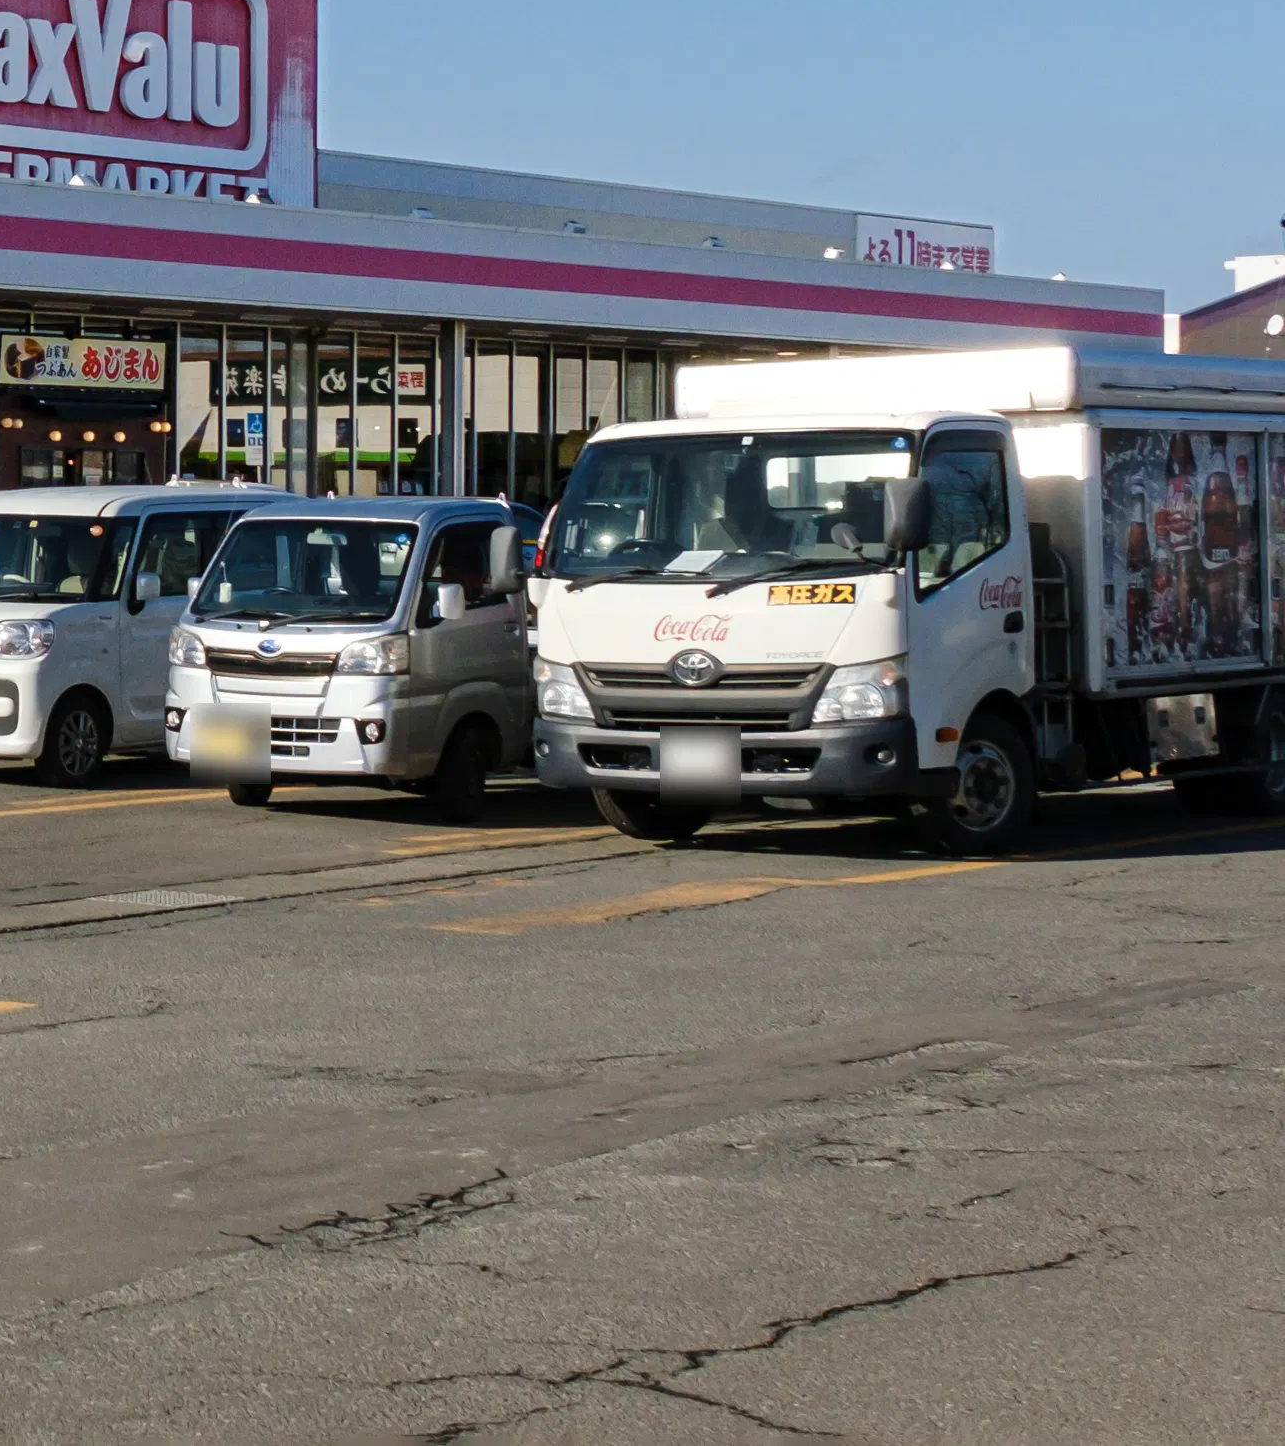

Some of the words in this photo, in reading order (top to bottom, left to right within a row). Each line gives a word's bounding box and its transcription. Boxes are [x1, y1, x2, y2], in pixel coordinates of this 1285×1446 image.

[35, 360, 78, 378] つぶあん
[81, 345, 160, 382] あじまん
[770, 584, 855, 604] 高圧ガス
